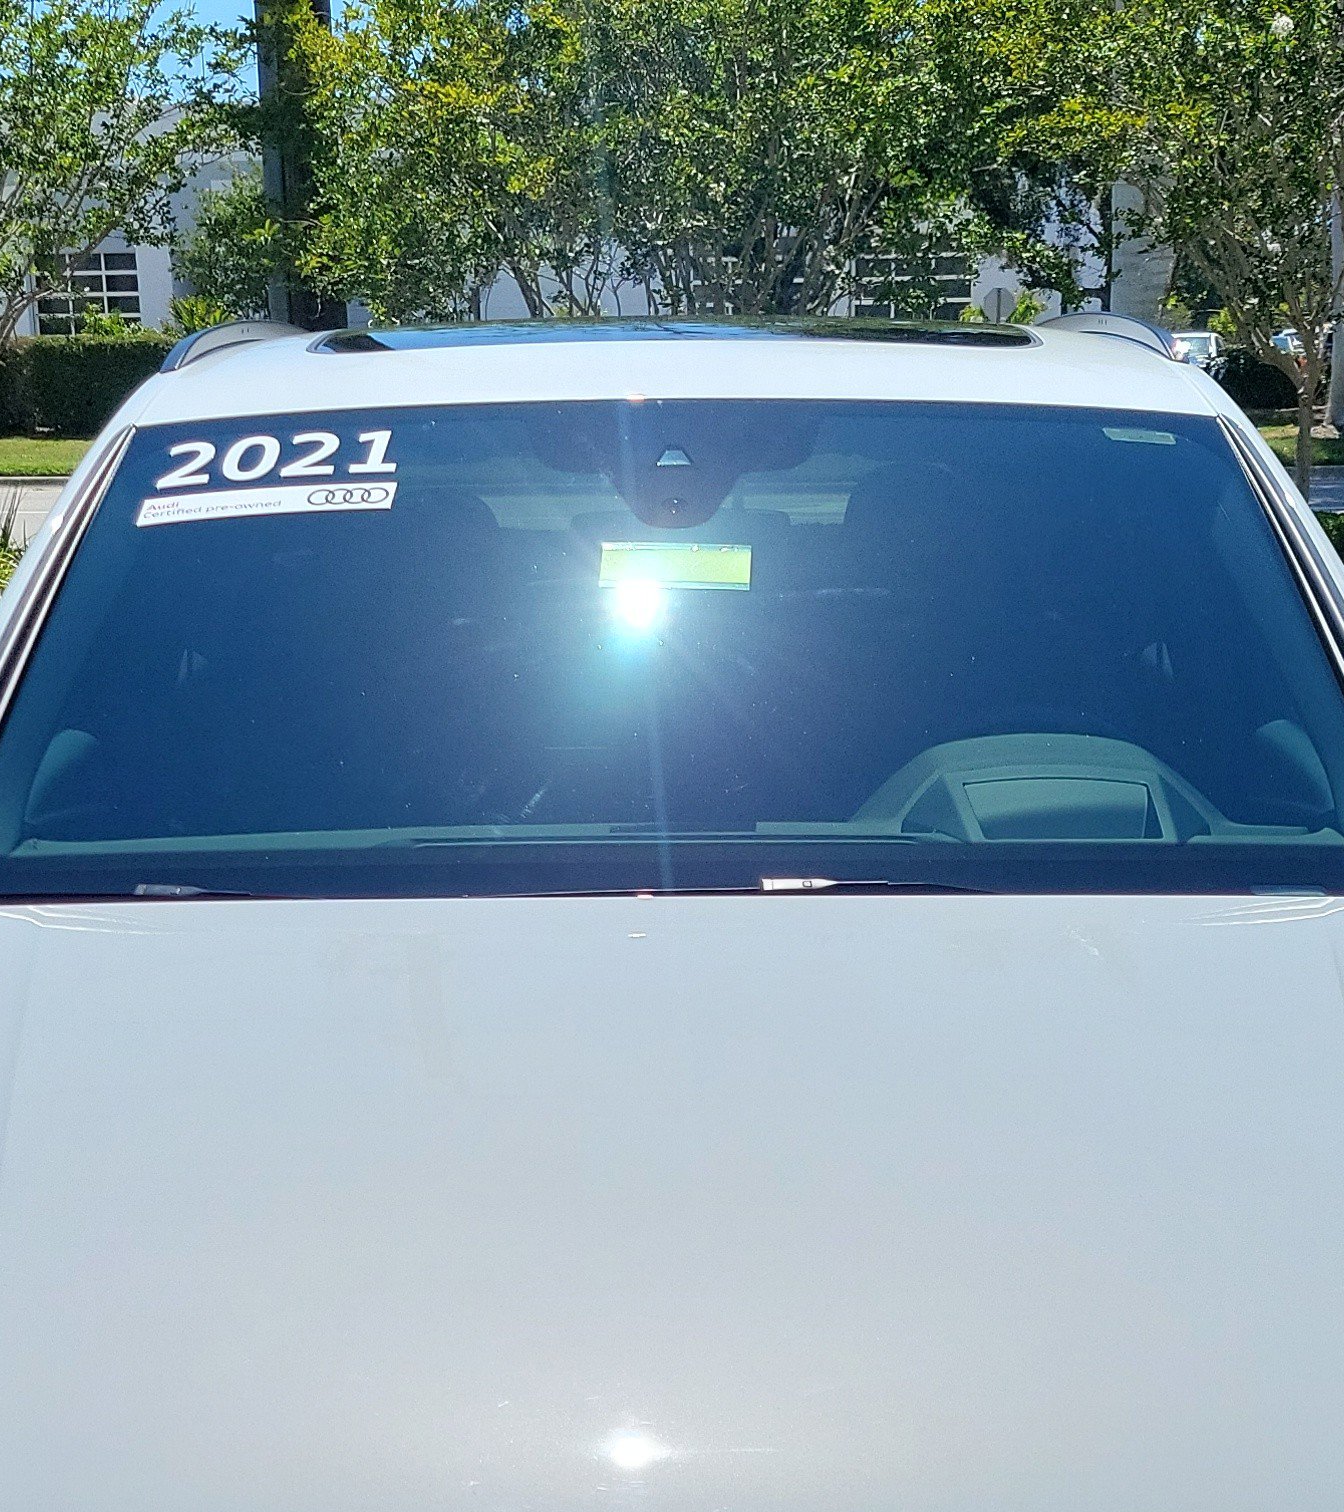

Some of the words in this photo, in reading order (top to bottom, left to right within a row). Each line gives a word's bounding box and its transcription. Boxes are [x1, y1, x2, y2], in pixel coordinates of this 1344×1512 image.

[156, 430, 397, 490] 2021
[146, 501, 180, 512] Audi
[205, 500, 282, 513] pre-owned
